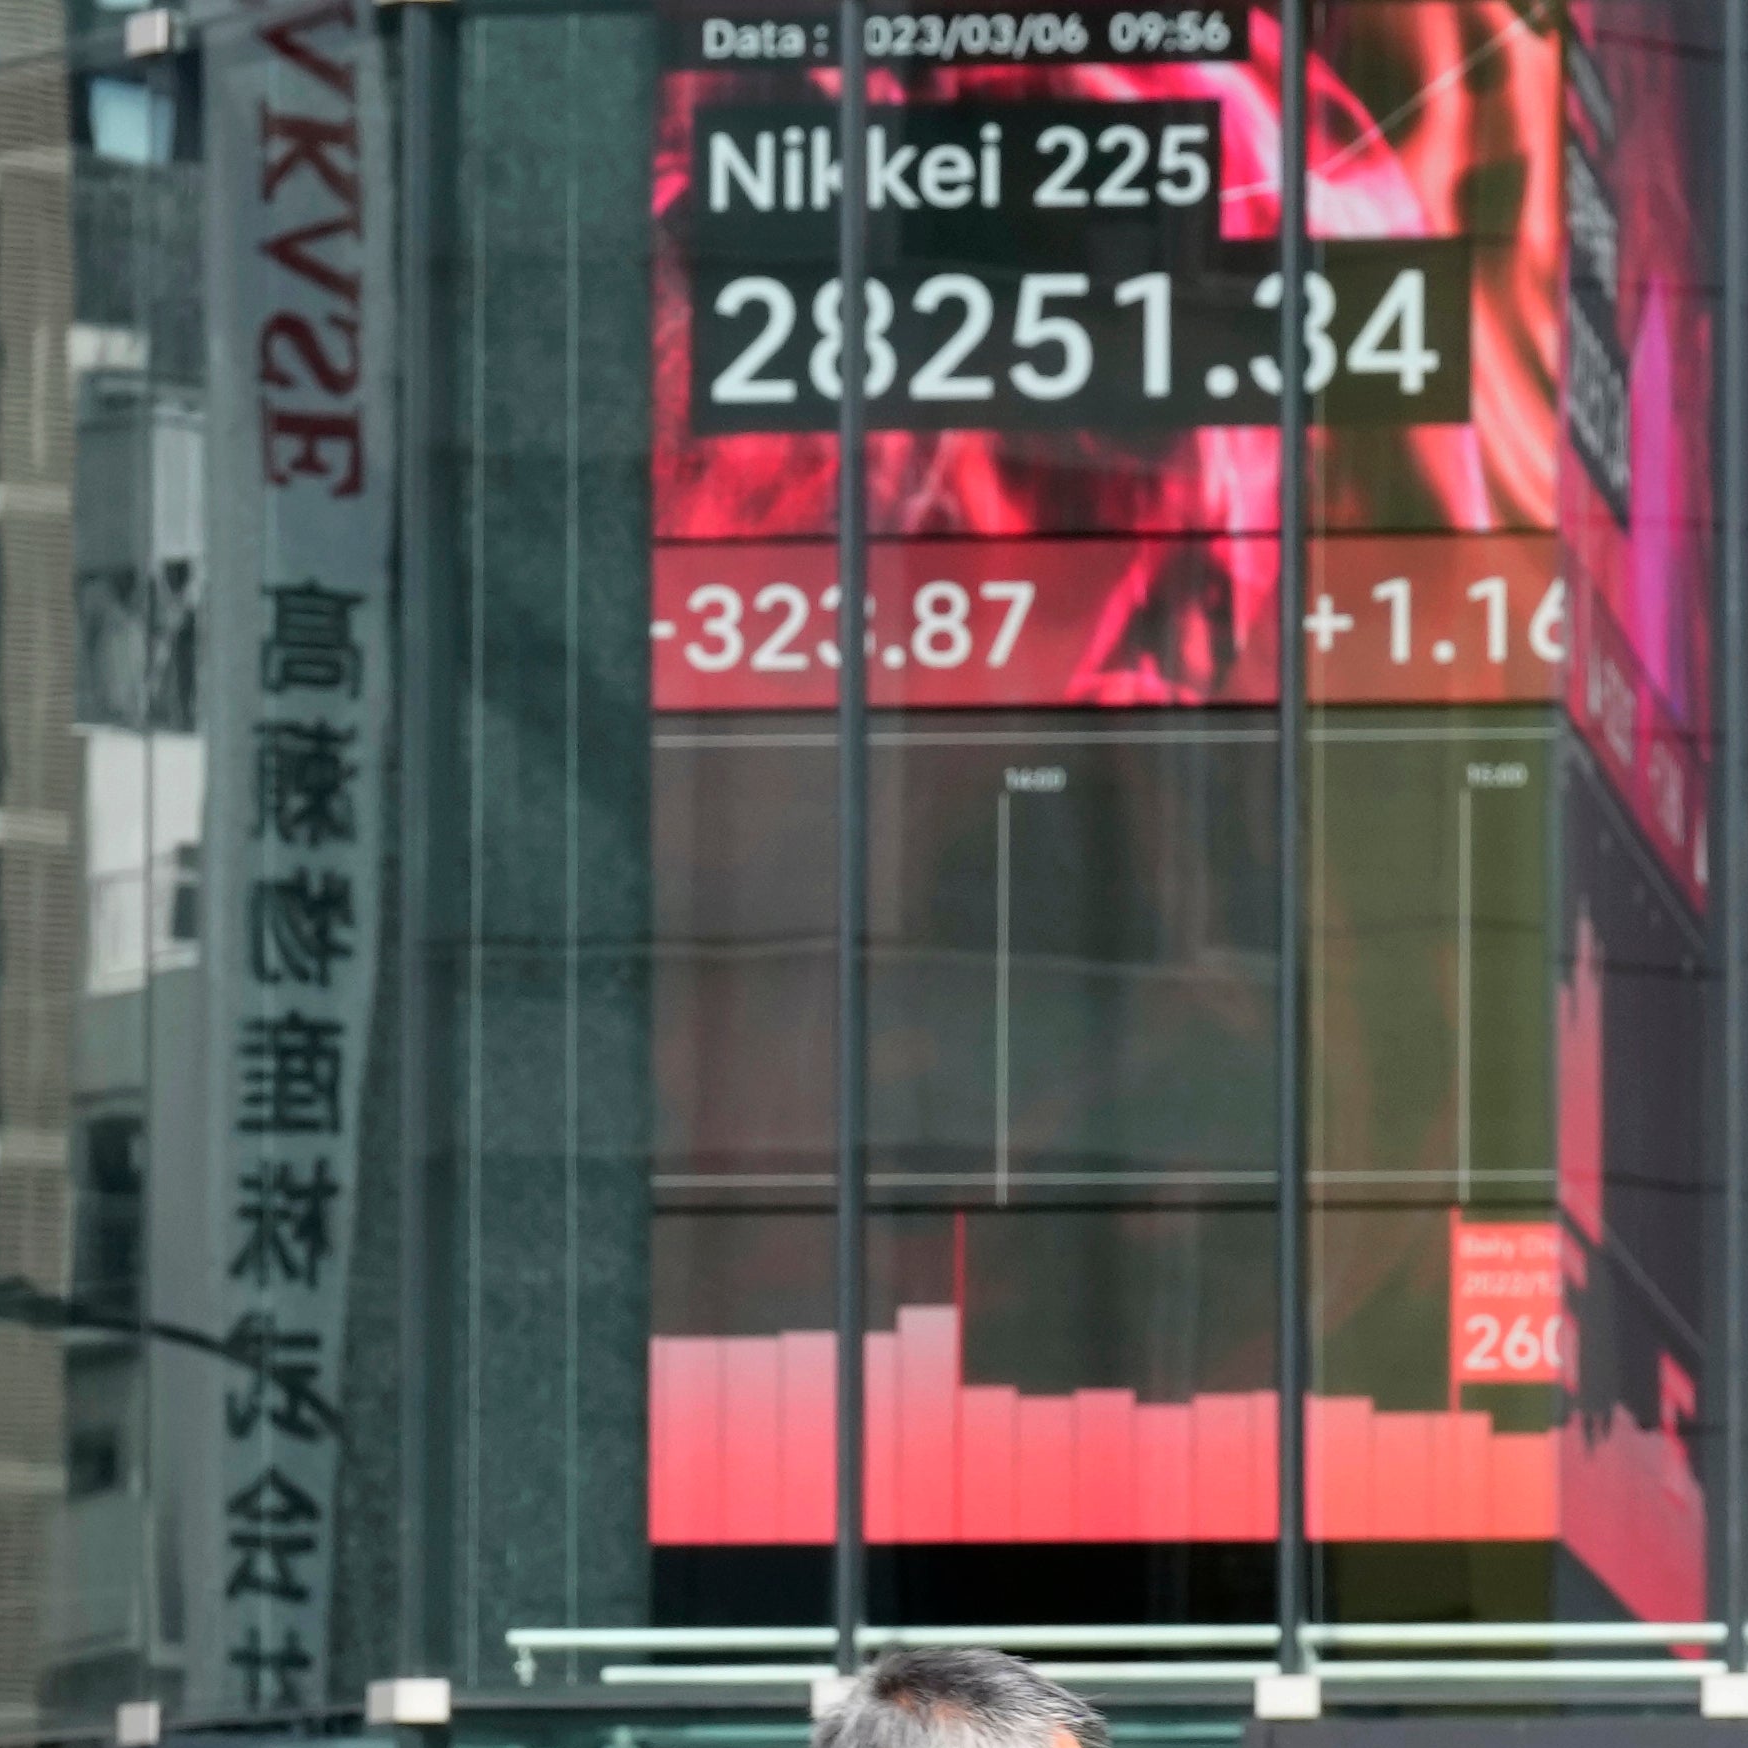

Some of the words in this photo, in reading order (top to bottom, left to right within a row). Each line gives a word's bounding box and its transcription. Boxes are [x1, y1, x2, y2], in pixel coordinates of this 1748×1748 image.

[864, 14, 1089, 60] 023/03/06
[1108, 11, 1232, 54] 09:56
[707, 123, 1002, 211] Nikkei
[1033, 125, 1212, 209] 225
[710, 269, 1440, 404] 28251.34
